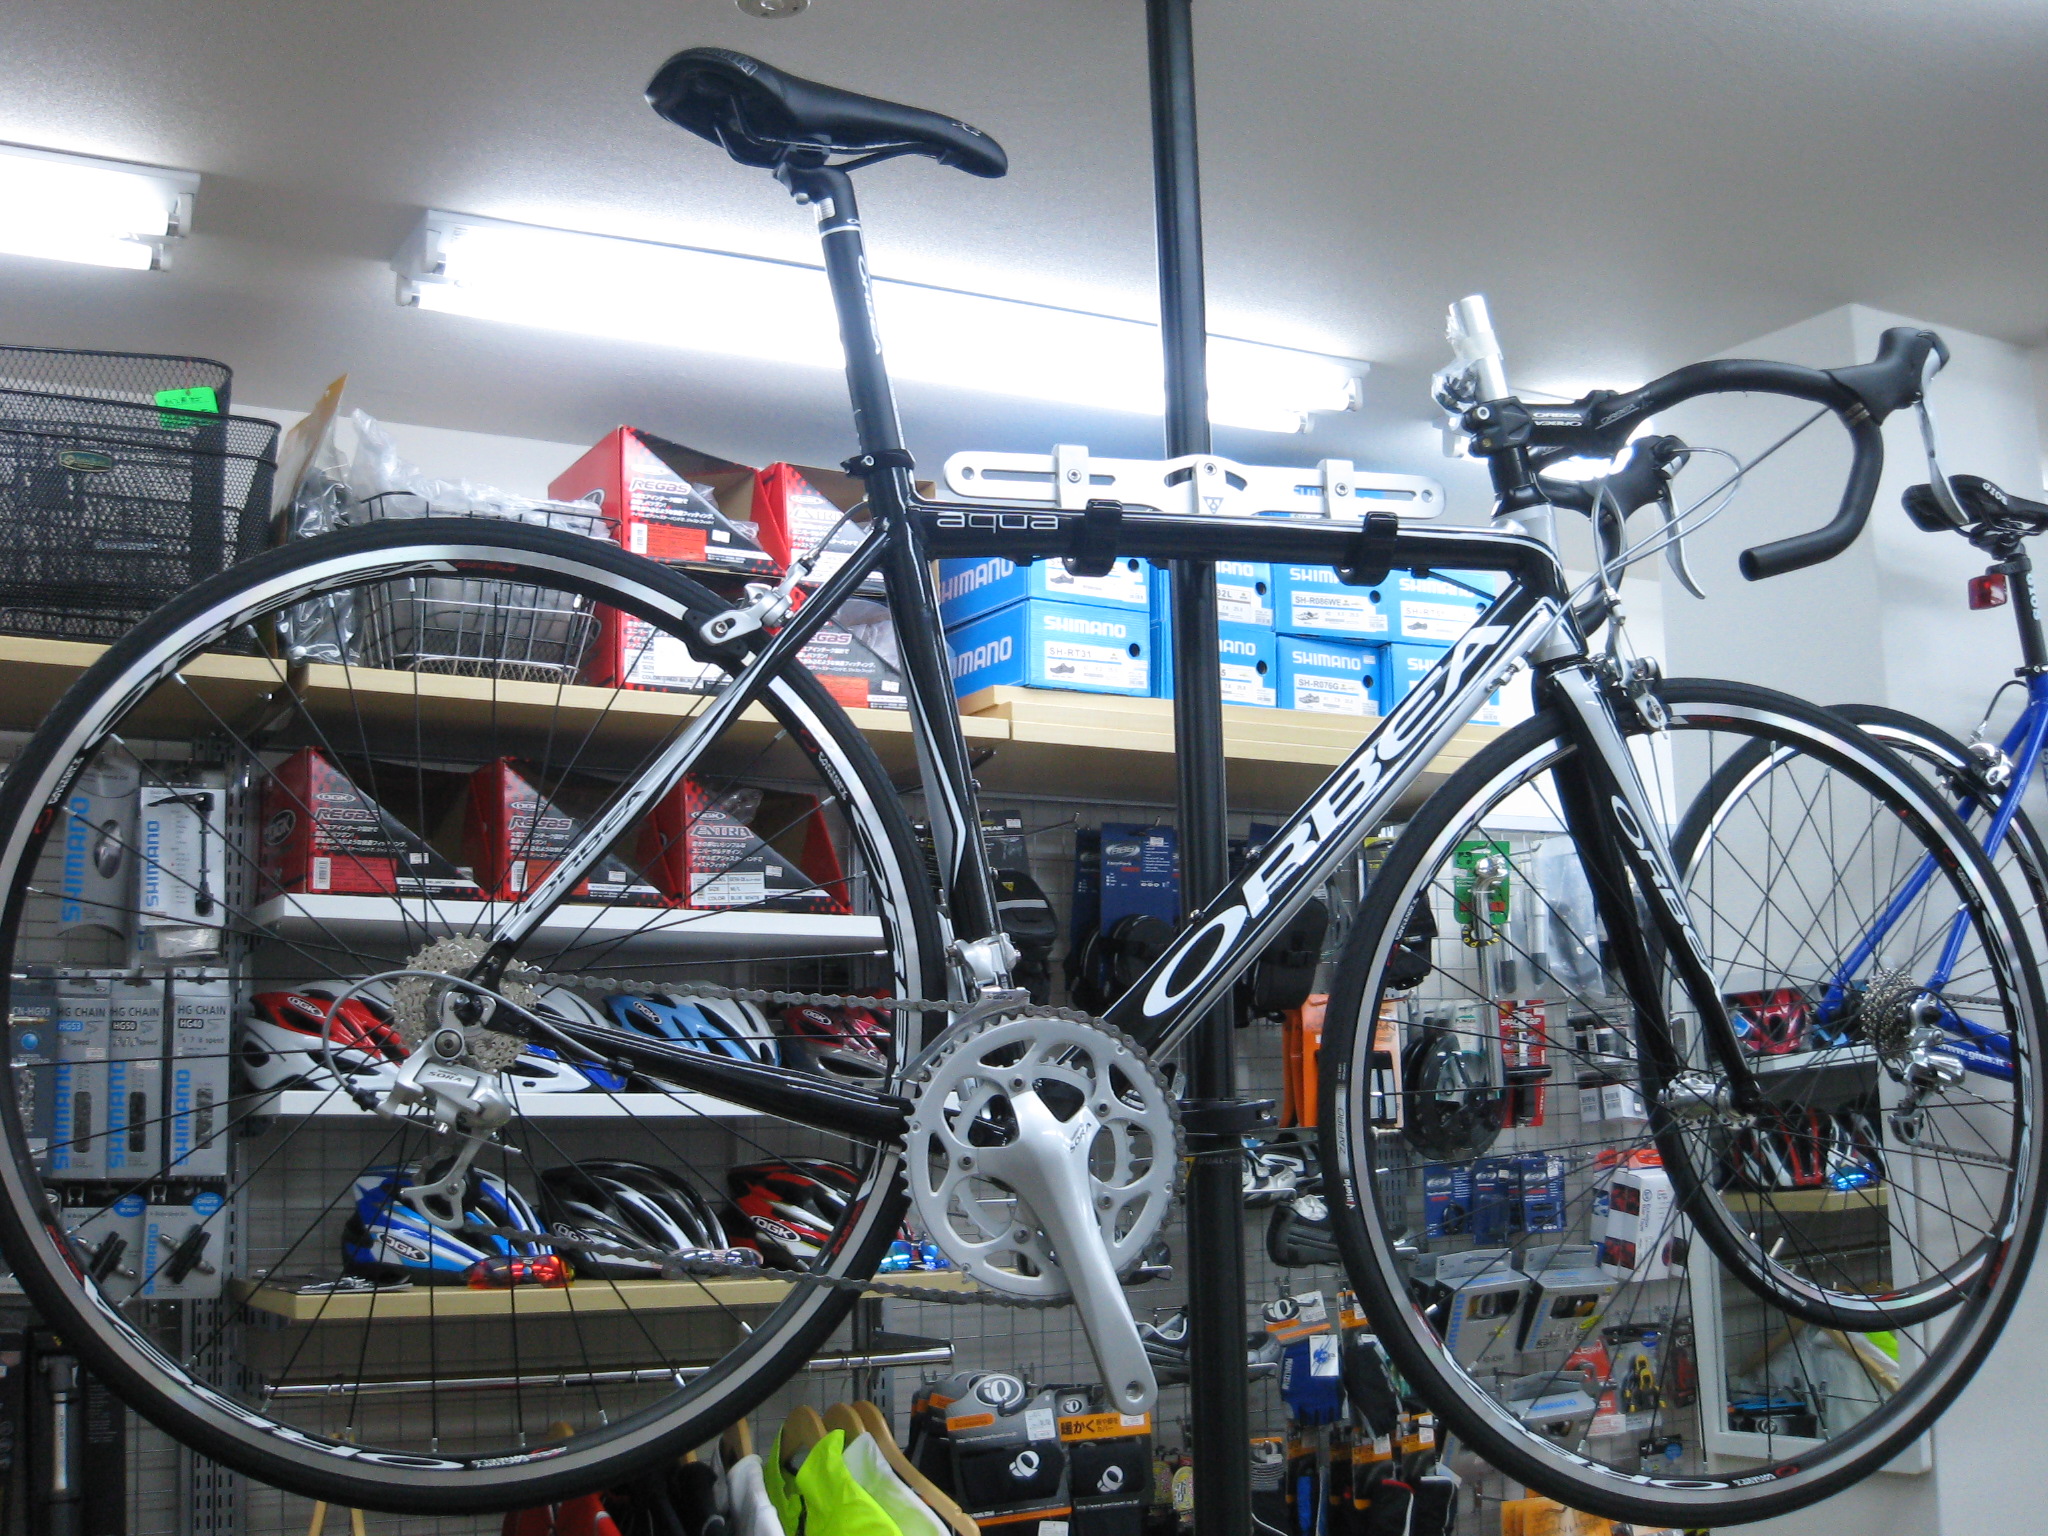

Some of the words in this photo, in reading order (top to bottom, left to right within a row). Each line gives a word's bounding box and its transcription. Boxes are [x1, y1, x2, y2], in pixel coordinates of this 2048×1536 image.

[630, 478, 690, 495] REGAS
[1981, 482, 2008, 505] GIOS
[937, 511, 1059, 533] aqua
[939, 557, 1014, 604] HIMANO
[2026, 573, 2041, 621] GIOS
[1043, 615, 1126, 638] SHIMANO
[84, 560, 458, 750] ORBEA
[1049, 647, 1092, 658] SH-RT31
[1292, 651, 1361, 670] SHIMANO
[1142, 625, 1510, 1018] ORBEA
[61, 797, 91, 923] SHIMANO
[146, 820, 160, 908] SHIMANO
[524, 790, 645, 914] ORBEA
[1610, 794, 1723, 1004] ORBEA
[57, 1007, 72, 1018] HG
[75, 1007, 106, 1018] CHAIN
[111, 1007, 125, 1017] HG
[129, 1007, 160, 1018] CHAIN
[177, 1005, 193, 1016] HG
[194, 1005, 226, 1016] CHAIN
[179, 1019, 203, 1029] HG40
[112, 1021, 136, 1031] HG50
[427, 1071, 463, 1083] SORA
[53, 1058, 72, 1170] SHIMANO
[109, 1060, 126, 1169] SHIMANO
[174, 1069, 191, 1166] SHIMANO
[1069, 1121, 1093, 1154] SORA
[754, 1218, 793, 1240] OGK
[384, 1234, 424, 1260] OGK
[84, 1274, 464, 1471] ORBEA
[1442, 1343, 1729, 1491] ORBEA
